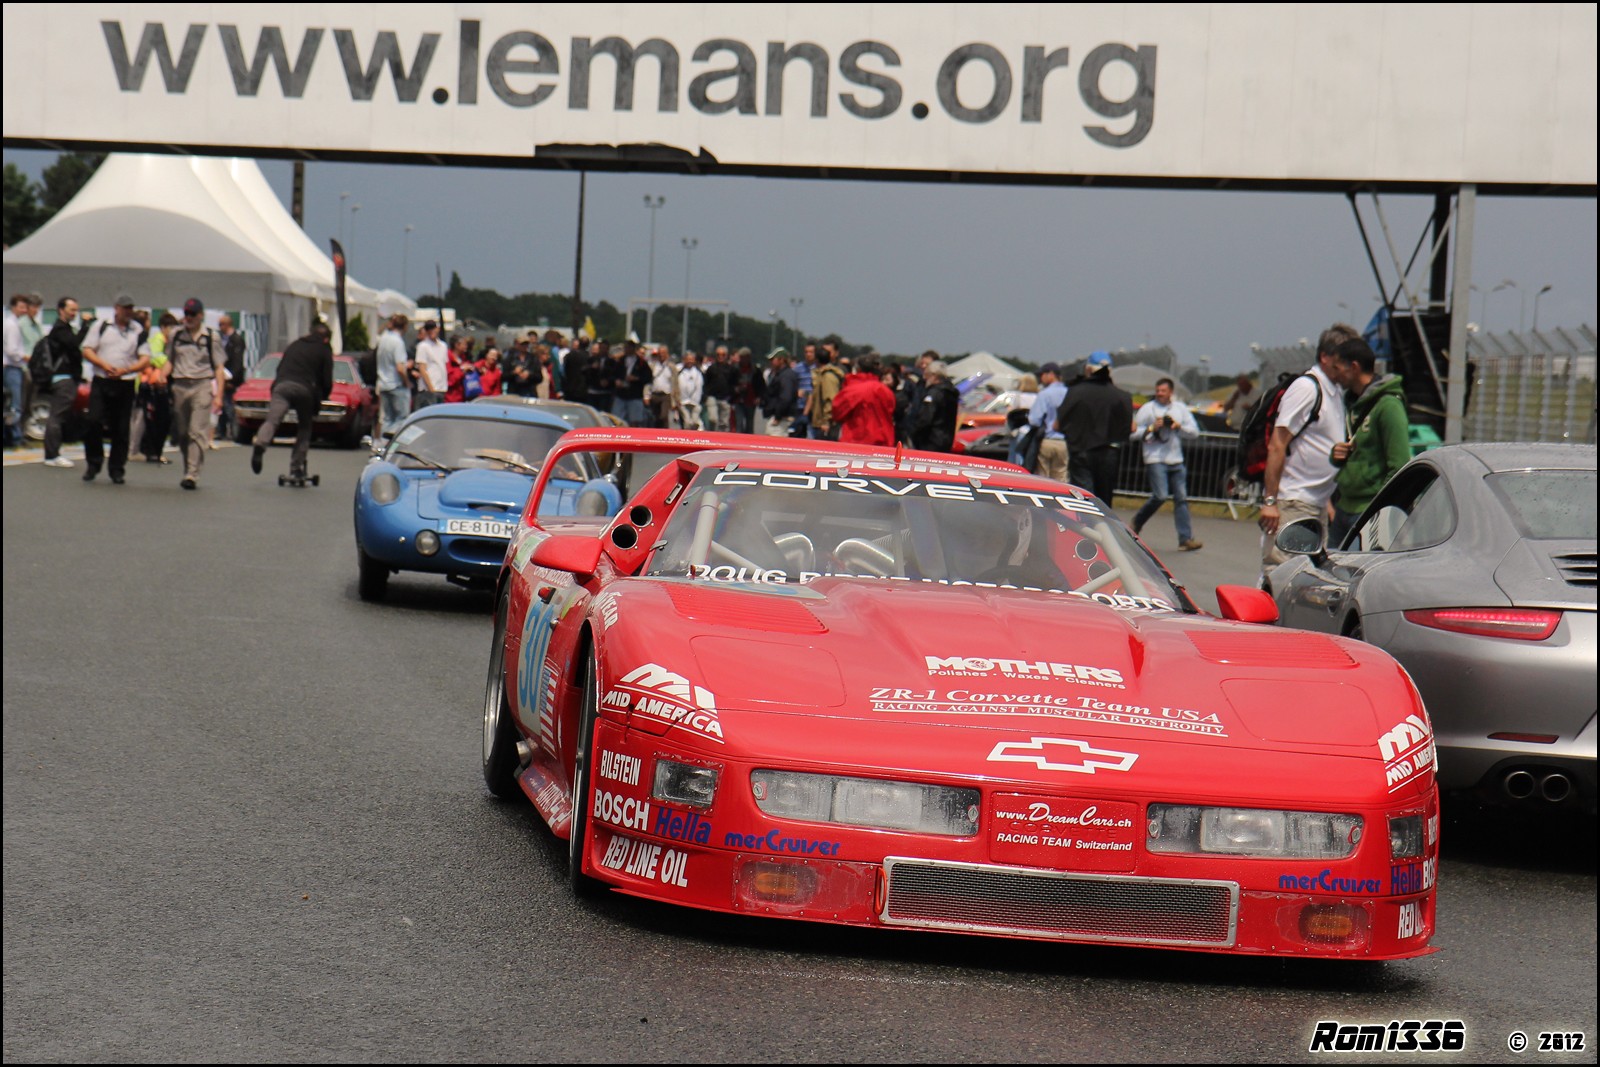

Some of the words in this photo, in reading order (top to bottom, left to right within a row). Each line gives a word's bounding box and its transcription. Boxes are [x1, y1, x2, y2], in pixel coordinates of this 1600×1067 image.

[101, 19, 1158, 148] www.lemans.org
[713, 471, 1106, 517] CORVETTE
[449, 520, 515, 536] CE-810-M
[925, 655, 1124, 683] MOTHERS
[928, 669, 988, 679] Polishes
[1003, 672, 1049, 681] Waxes
[1065, 676, 1126, 690] Cleaners
[602, 690, 631, 706] MID
[635, 697, 724, 738] AMERICA
[869, 687, 937, 701] ZR-1
[946, 689, 1069, 706] Corvette
[1076, 696, 1151, 715] Team
[1161, 706, 1223, 724] USA
[873, 702, 938, 711] RACING
[948, 704, 1018, 714] AGAINST
[1028, 707, 1121, 723] MUSCULAR
[1128, 716, 1224, 735] DYSTROPHY
[600, 749, 641, 786] BILSTEIN
[1385, 764, 1414, 787] MID
[593, 788, 650, 831] BOSCH
[654, 806, 712, 844] Hella
[996, 802, 1132, 827] www.DreamCars.ch
[724, 829, 841, 855] merCruiser
[996, 833, 1039, 845] RACING
[1042, 836, 1071, 848] TEAM
[1075, 840, 1133, 851] Switzerland
[601, 835, 628, 871] RED
[626, 841, 661, 878] LINE
[661, 849, 688, 887] OIL
[1279, 869, 1381, 893] merCruiser
[1390, 863, 1421, 895] Hella
[1397, 905, 1414, 939] RED
